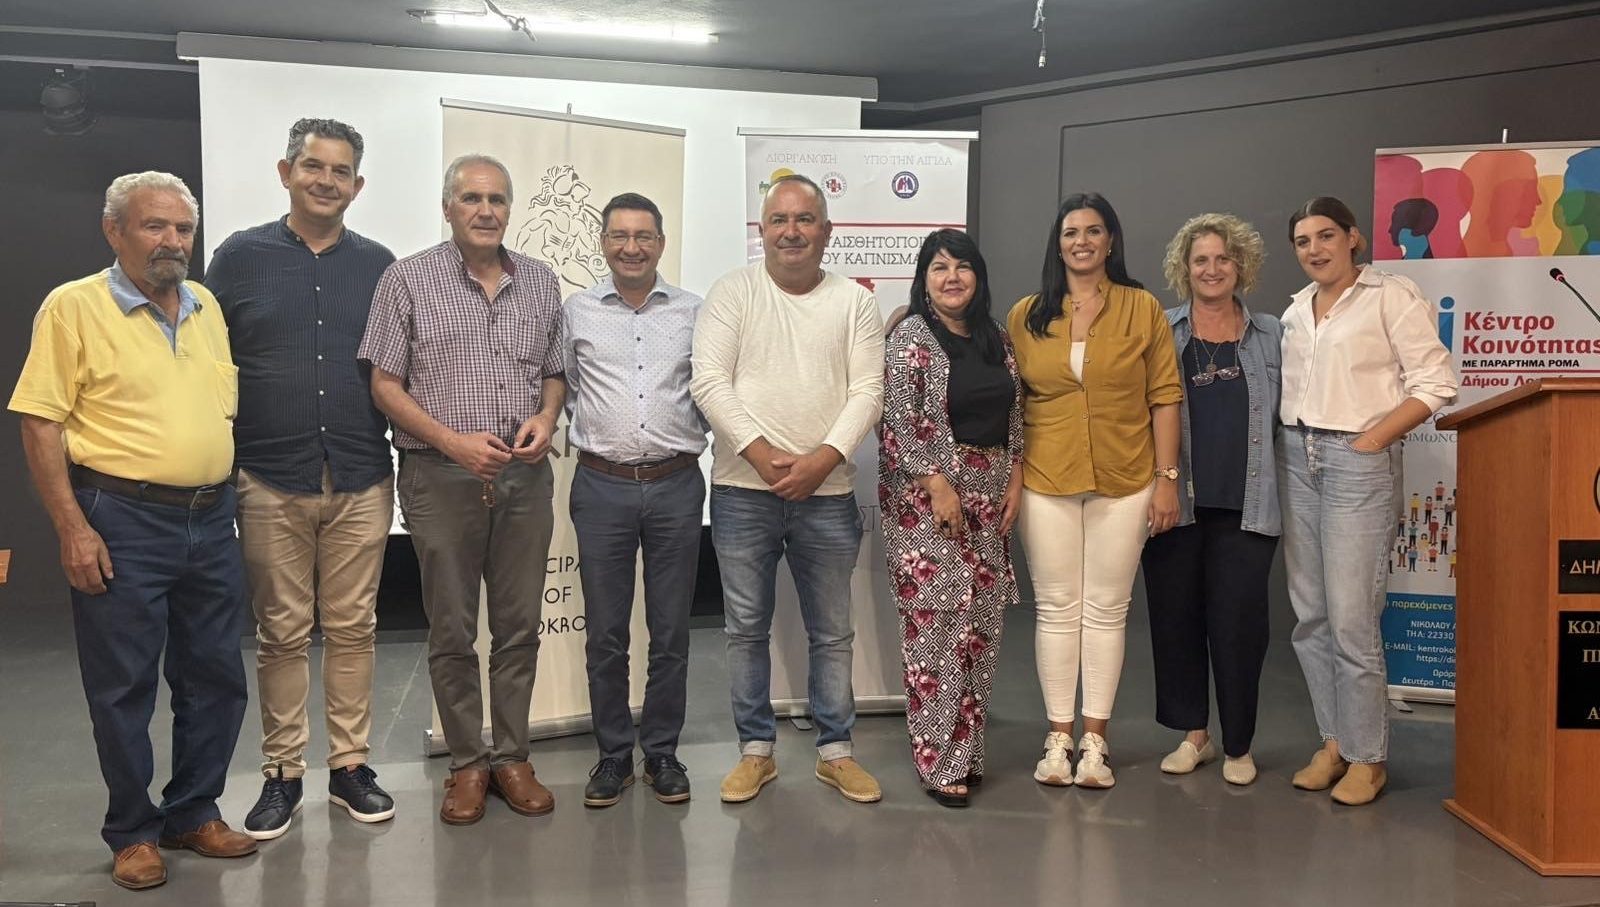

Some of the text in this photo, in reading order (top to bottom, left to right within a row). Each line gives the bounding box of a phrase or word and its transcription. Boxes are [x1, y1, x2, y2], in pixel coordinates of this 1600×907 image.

[864, 155, 952, 166] ΥΠΟ ΤΗΝ ΑΙΓΙΔΑ
[1464, 311, 1555, 334] Κέντρο
[1462, 335, 1600, 355] Κοινότητας
[1462, 359, 1580, 368] ΜΕ ΠΑΡΑΡΤΗΜΑ ΡΟΜΑ
[1461, 375, 1509, 388] Δήμου
[544, 586, 572, 604] OF
[1392, 600, 1453, 611] παρεχόμενες
[1411, 620, 1451, 629] ΝΙΚΟΛΑΟΥ
[1427, 631, 1454, 640] 22330
[1402, 677, 1434, 686] Δευτέρα
